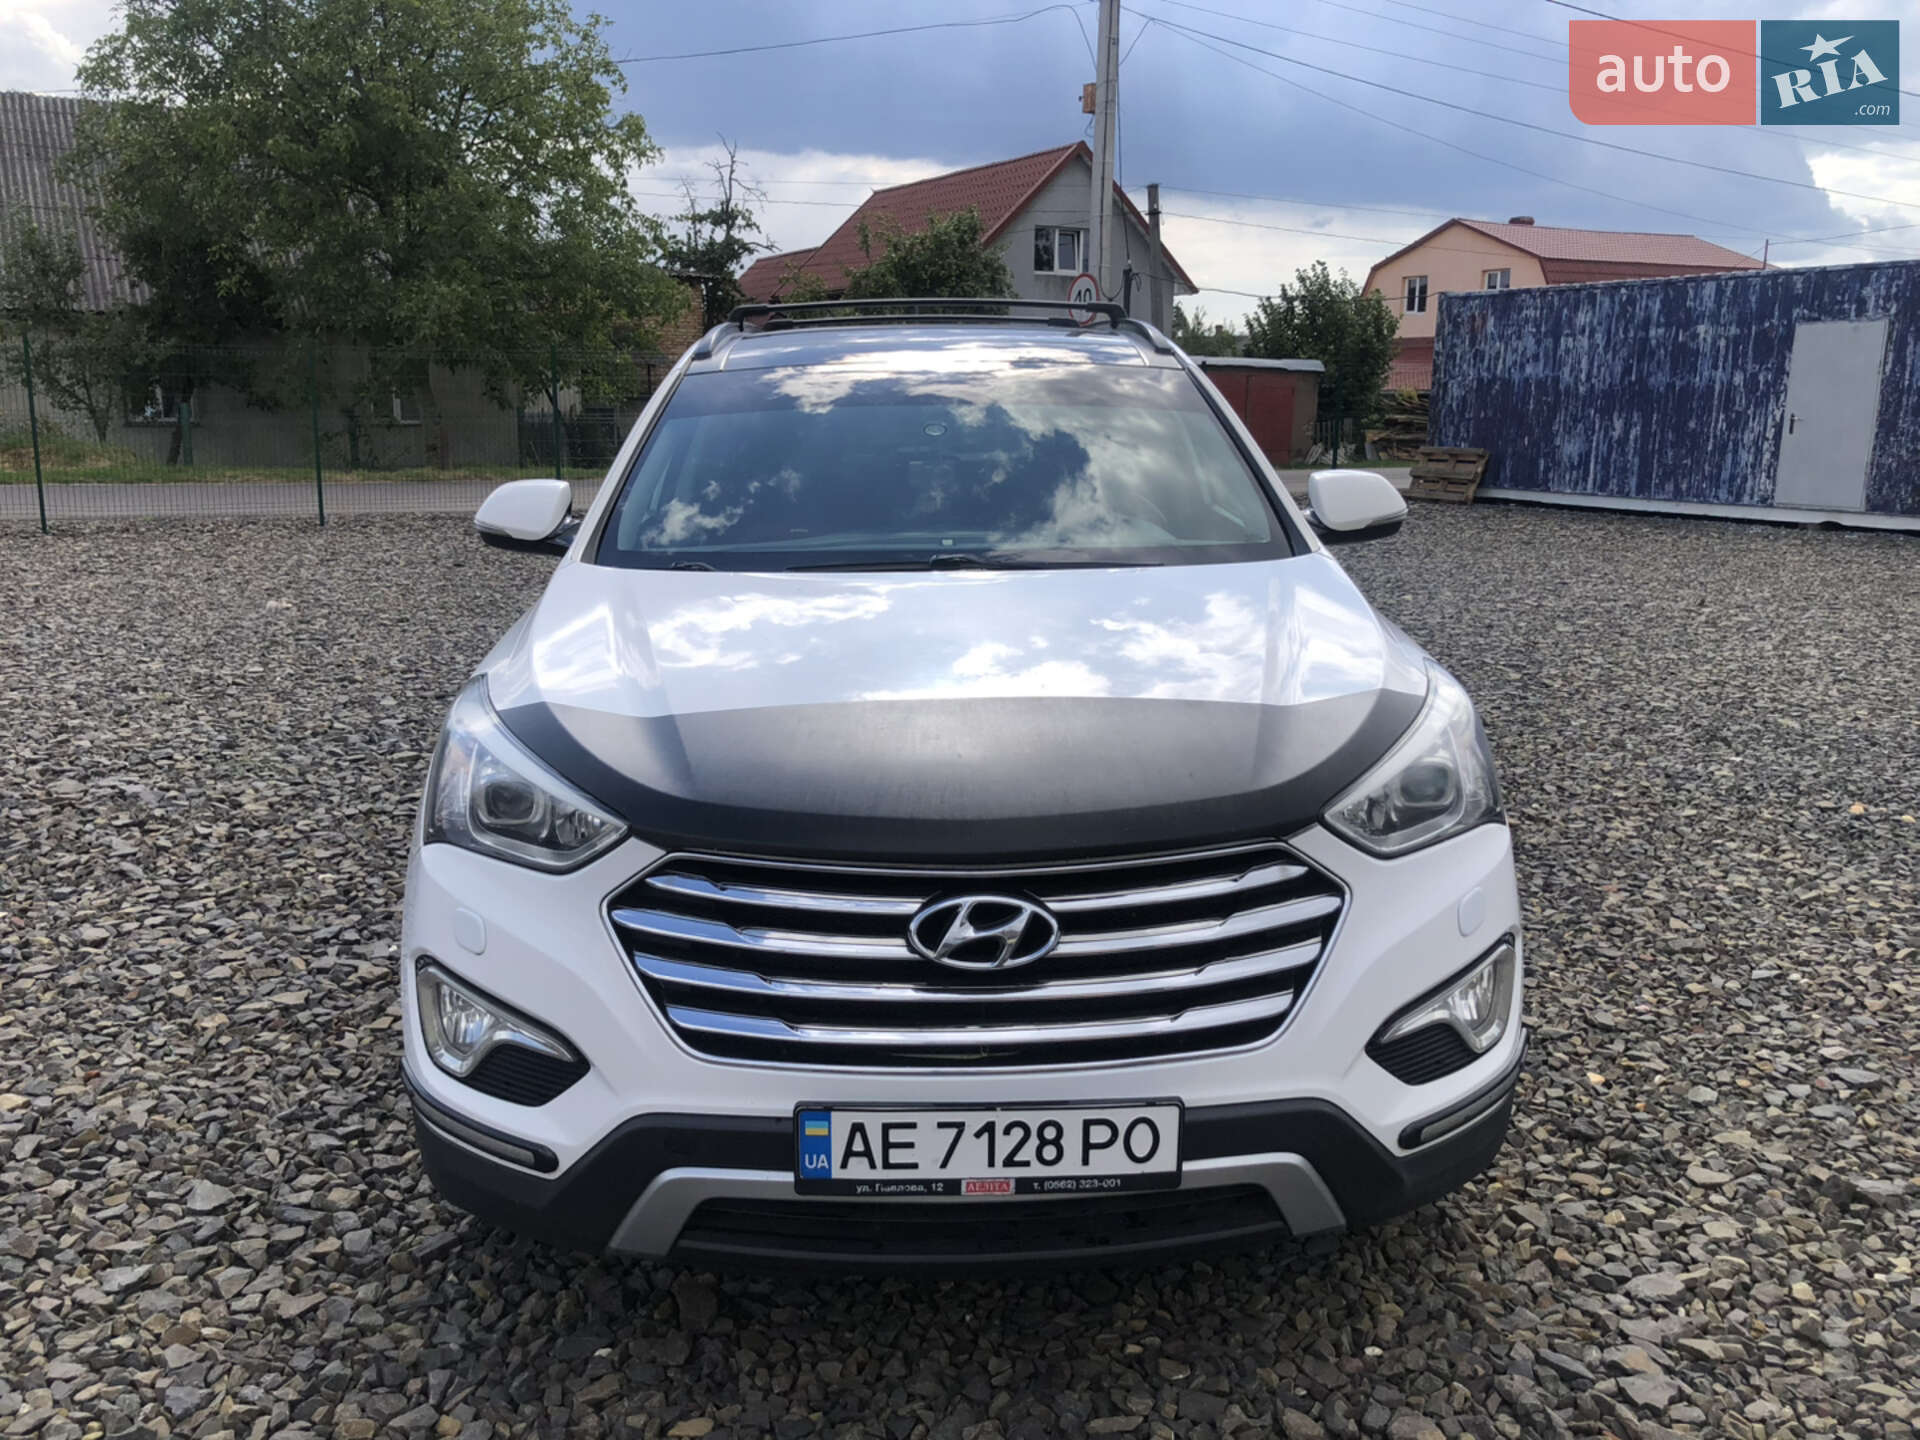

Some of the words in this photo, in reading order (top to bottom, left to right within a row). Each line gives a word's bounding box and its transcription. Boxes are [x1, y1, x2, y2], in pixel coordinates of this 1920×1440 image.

[840, 1121, 919, 1170] AE
[936, 1119, 1065, 1169] 7128
[1081, 1116, 1161, 1165] PO
[804, 1153, 829, 1169] UA
[931, 1182, 944, 1192] 12
